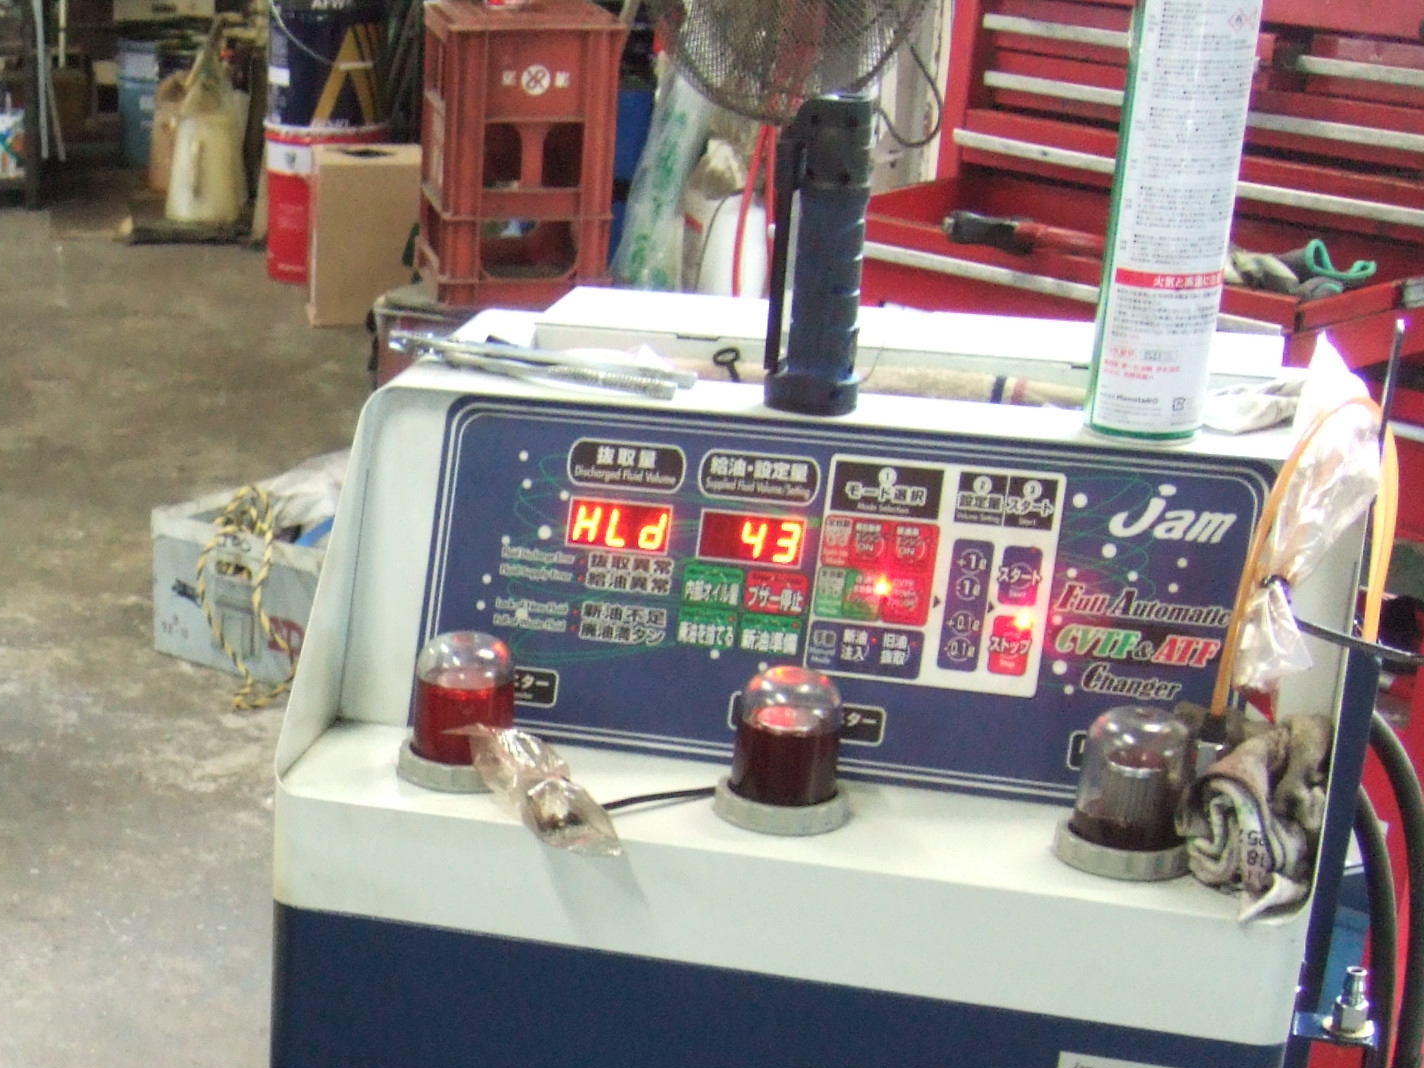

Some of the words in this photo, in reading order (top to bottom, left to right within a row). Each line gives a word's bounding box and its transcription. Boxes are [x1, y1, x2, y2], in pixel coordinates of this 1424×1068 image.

[596, 445, 657, 470] 抜取量
[845, 481, 927, 507] モード選択
[1005, 497, 1054, 517] スタート
[741, 520, 802, 564] 43
[997, 565, 1042, 587] スタート
[747, 583, 804, 612] ブザー停止
[1054, 581, 1110, 615] Full
[1108, 586, 1232, 628] Automatic
[580, 601, 667, 629] 新油不足
[989, 635, 1032, 654] ストップ
[1081, 661, 1182, 700] Changer
